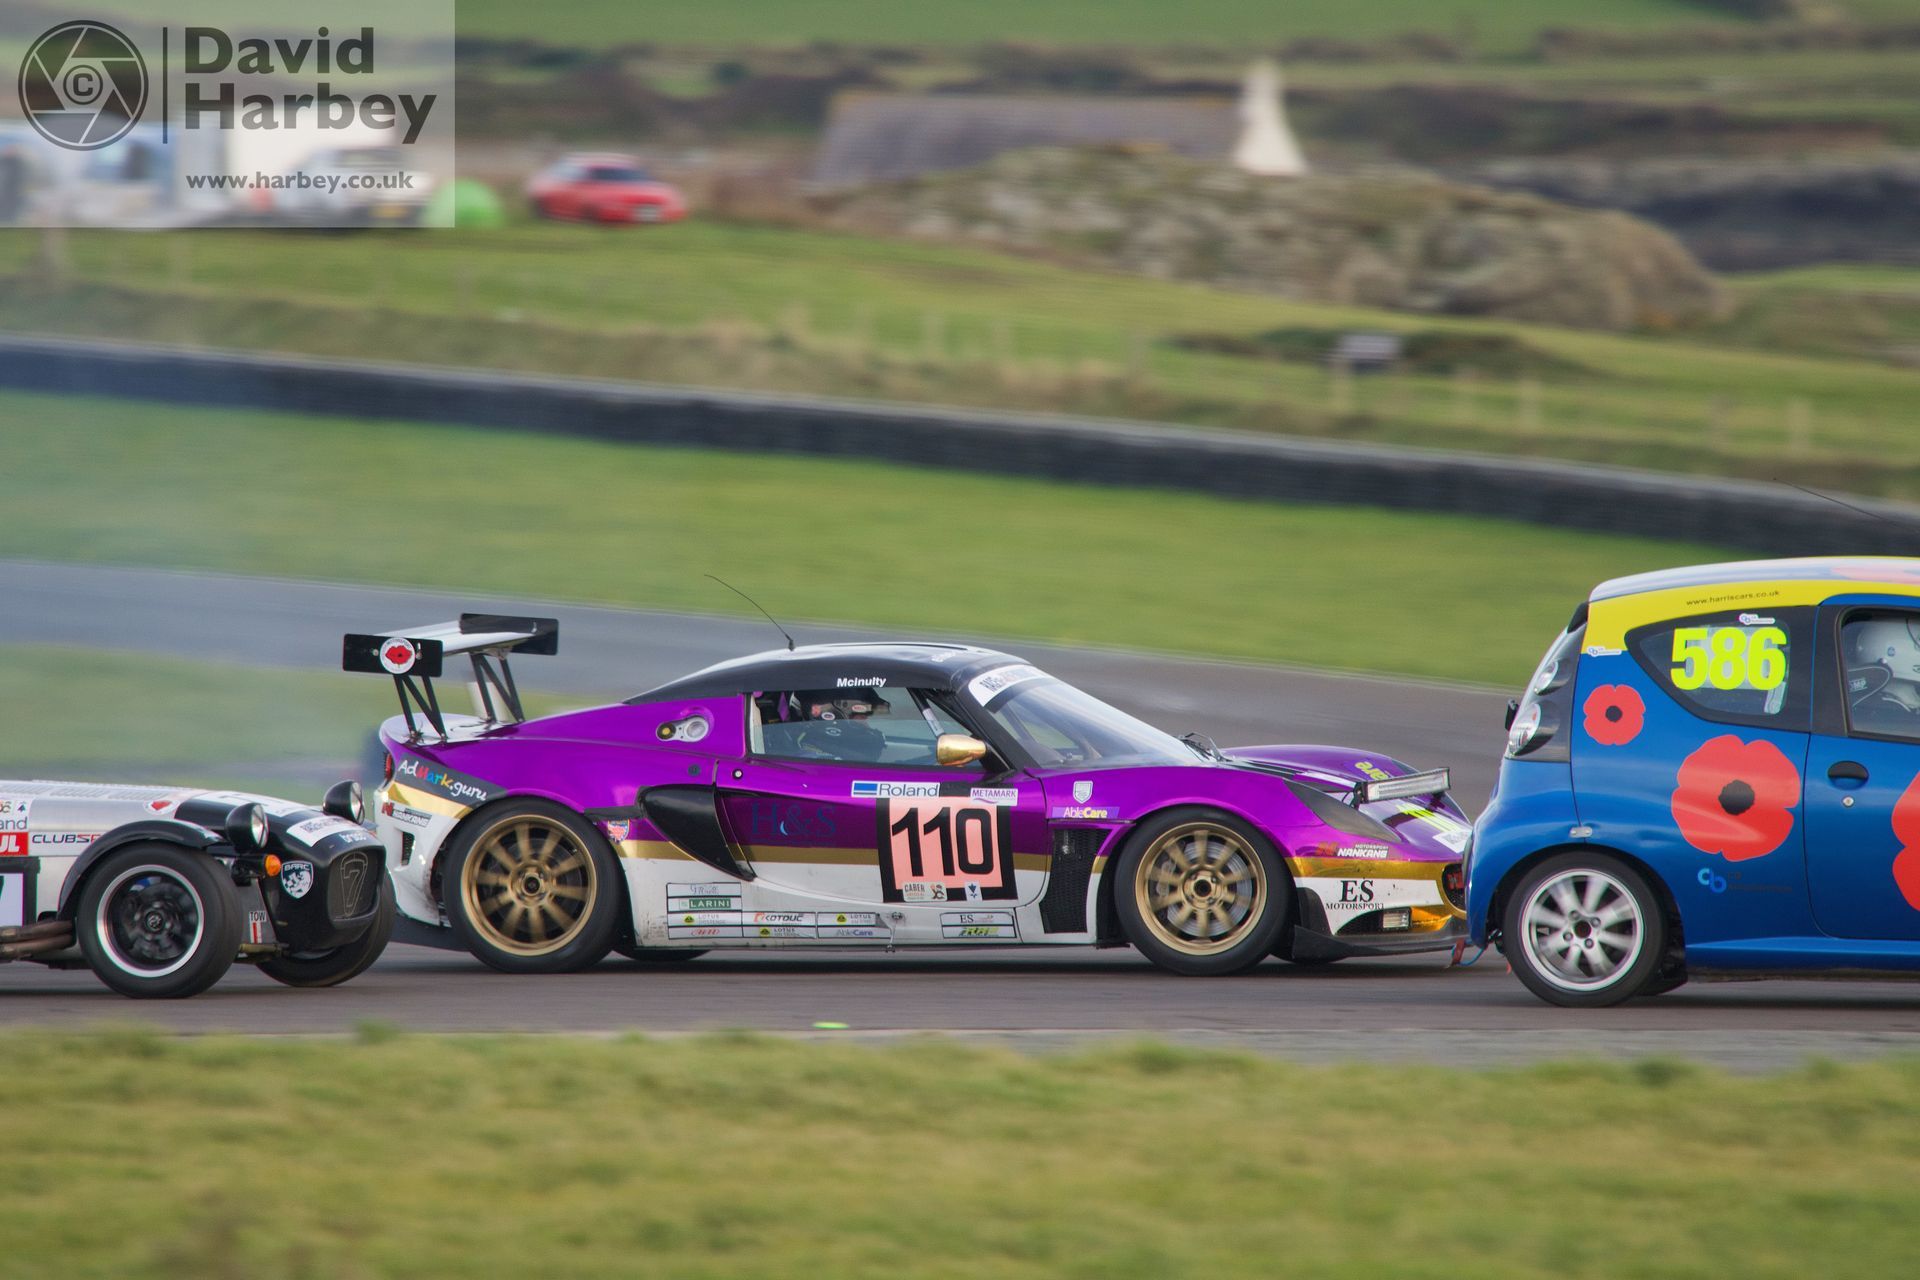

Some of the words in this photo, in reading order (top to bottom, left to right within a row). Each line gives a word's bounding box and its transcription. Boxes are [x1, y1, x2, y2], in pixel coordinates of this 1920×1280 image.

[1671, 627, 1787, 690] 586
[398, 760, 487, 801] AdMark.guru
[878, 782, 940, 797] Roland
[972, 789, 1017, 798] METAMARK
[1063, 806, 1108, 819] AbleCare
[891, 807, 995, 877] 110
[1337, 848, 1388, 858] NANKANG
[284, 863, 310, 872] BARC
[1339, 880, 1374, 902] ES
[690, 900, 730, 908] LARINI
[1326, 903, 1385, 911] MOTORSPORT
[249, 911, 267, 921] TOW
[959, 914, 975, 924] ES
